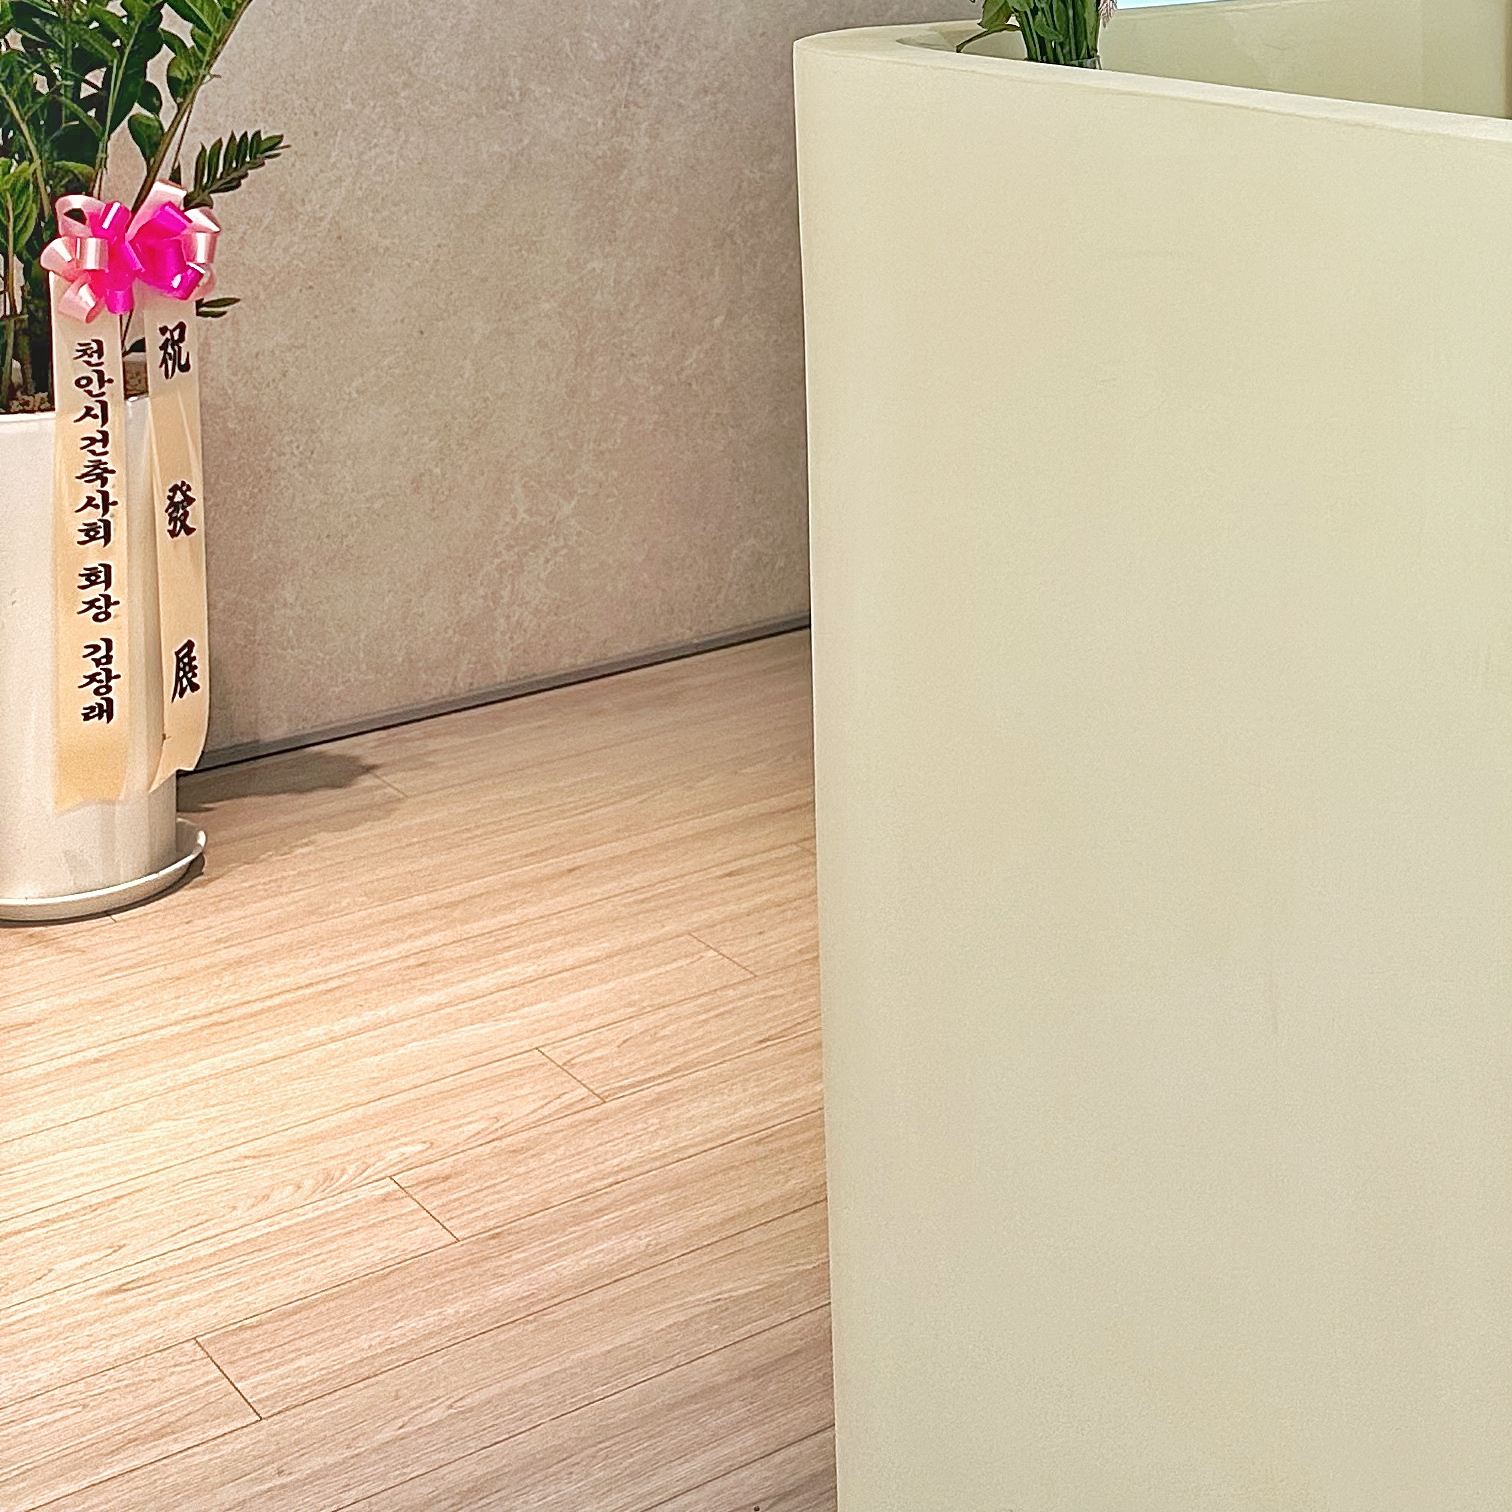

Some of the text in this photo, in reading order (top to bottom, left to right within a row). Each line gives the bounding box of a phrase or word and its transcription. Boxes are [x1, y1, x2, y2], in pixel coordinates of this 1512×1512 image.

[73, 338, 122, 724] 천안시건축사회 회장 김장래
